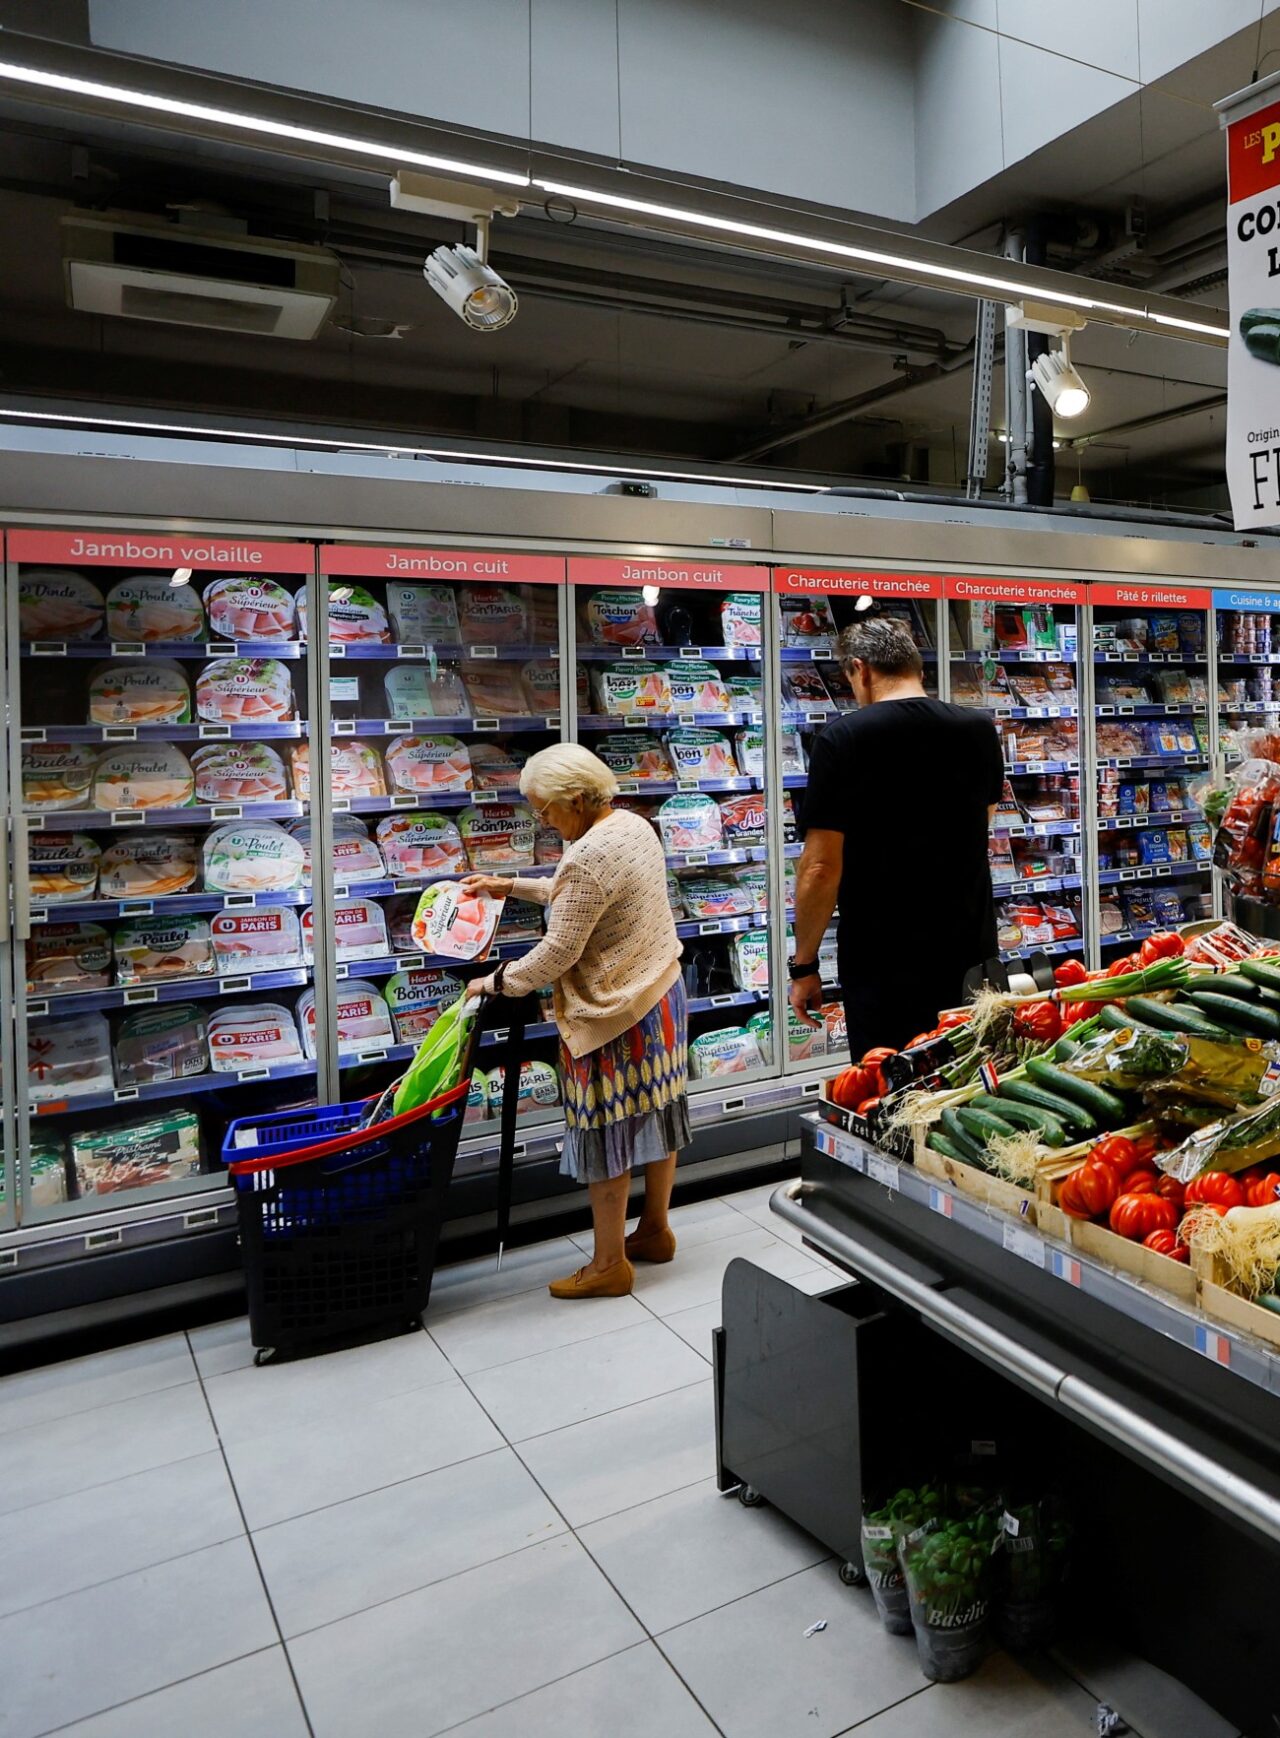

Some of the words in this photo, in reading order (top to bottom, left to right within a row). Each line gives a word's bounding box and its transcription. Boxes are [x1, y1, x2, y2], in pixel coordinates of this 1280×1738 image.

[1243, 130, 1262, 149] LES
[70, 540, 174, 560] Jambon
[180, 546, 263, 564] volaille
[386, 554, 467, 573] Jambon
[473, 558, 509, 575] cuit
[621, 565, 688, 583] Jambon
[694, 569, 723, 584] cuit
[787, 574, 870, 592] Charcuterie
[873, 577, 931, 592] tranchée
[955, 582, 1026, 598] Charcuterie
[1027, 585, 1078, 599] tranchée
[1116, 590, 1139, 602] Pâté
[1141, 592, 1149, 602] &
[1151, 591, 1188, 604] rillettes
[229, 597, 279, 609] Supérieur
[1230, 594, 1263, 607] Cuisine
[1264, 597, 1272, 607] &
[594, 604, 638, 617] Torchon
[214, 684, 268, 695] Supérieur
[408, 750, 453, 761] Supérieur
[677, 745, 703, 759] bon
[130, 762, 168, 773] Poulet
[213, 770, 267, 780] Supérieur
[468, 820, 497, 832] Bon
[497, 819, 532, 830] PARIS
[247, 837, 284, 851] Poulet
[397, 835, 443, 844] Supérieur
[240, 920, 278, 931] PARIS
[336, 914, 364, 924] ARIS
[141, 930, 191, 946] Poulet
[411, 974, 437, 984] Herta
[393, 986, 424, 1000] Bon
[425, 982, 461, 997] PARIS
[239, 1034, 277, 1044] PARIS
[520, 1071, 552, 1086] PARIS
[928, 1600, 988, 1628] Basilic
